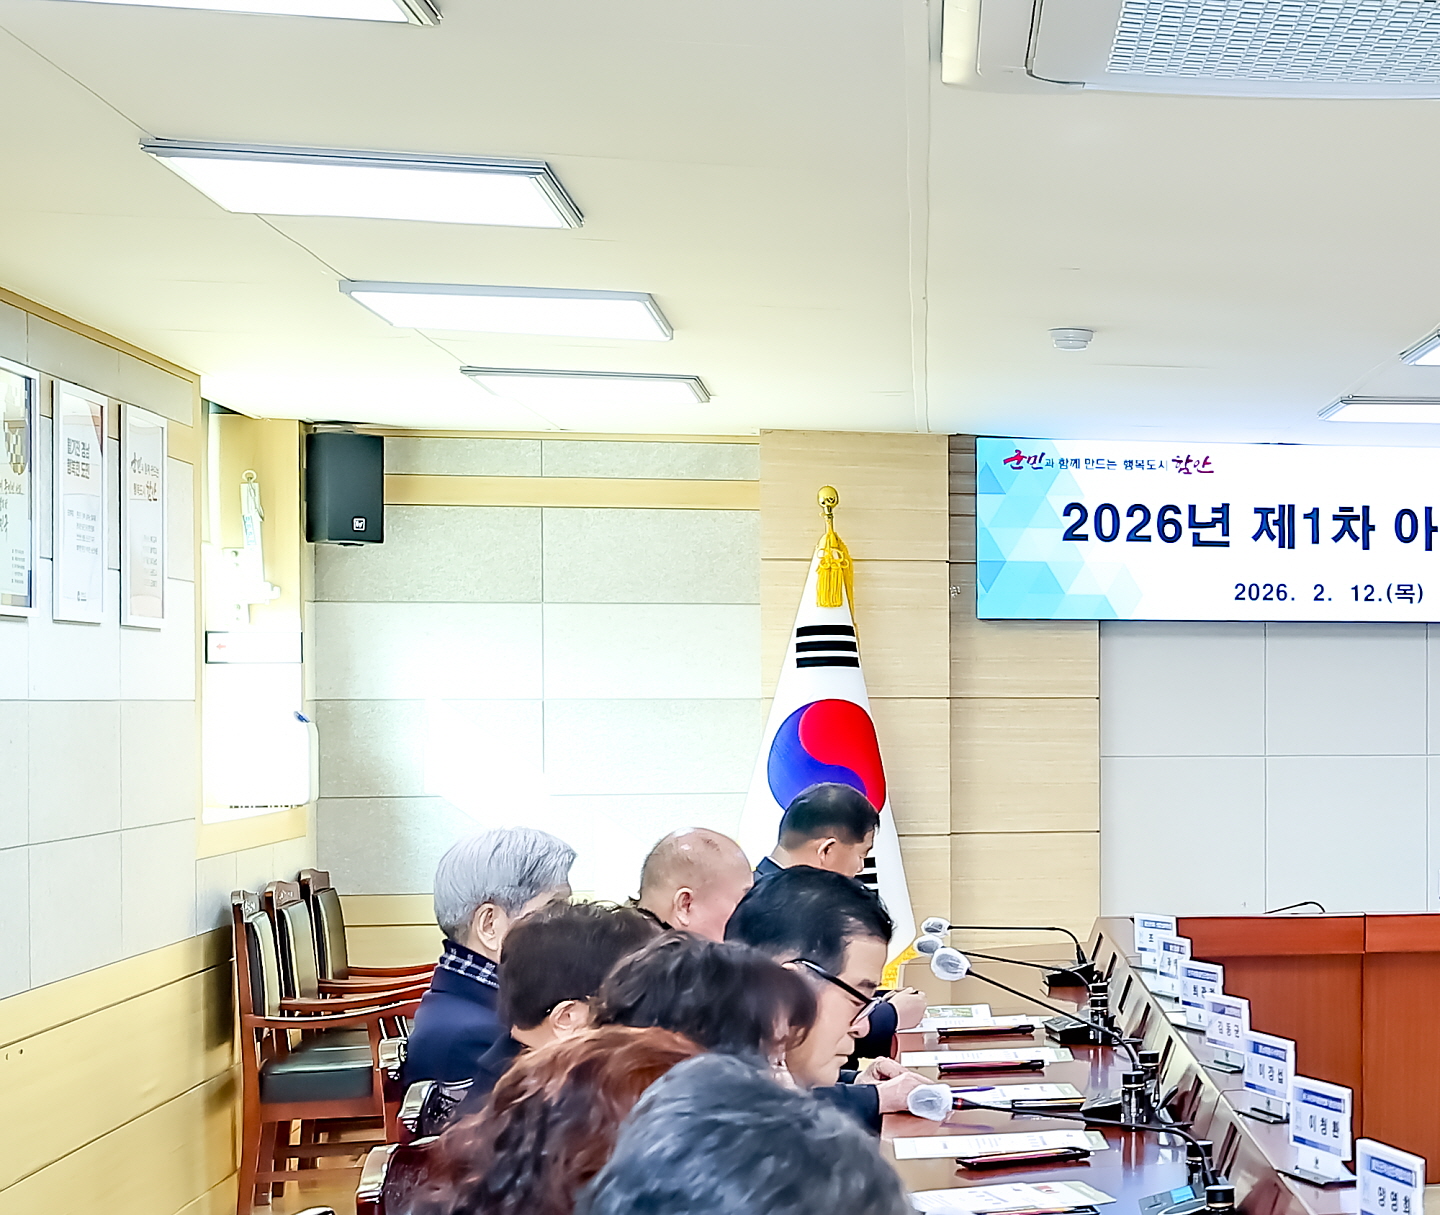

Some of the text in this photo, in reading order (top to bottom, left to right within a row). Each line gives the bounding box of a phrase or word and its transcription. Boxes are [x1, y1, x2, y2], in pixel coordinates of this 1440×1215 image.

[1002, 449, 1214, 475] 군민과 함께 만드는 행복도시 함안
[1062, 502, 1231, 548] 2026년
[1251, 504, 1376, 551] 제1차
[1233, 582, 1296, 601] 2026.
[1312, 583, 1333, 602] 2.
[1350, 582, 1424, 604] 12.(목)
